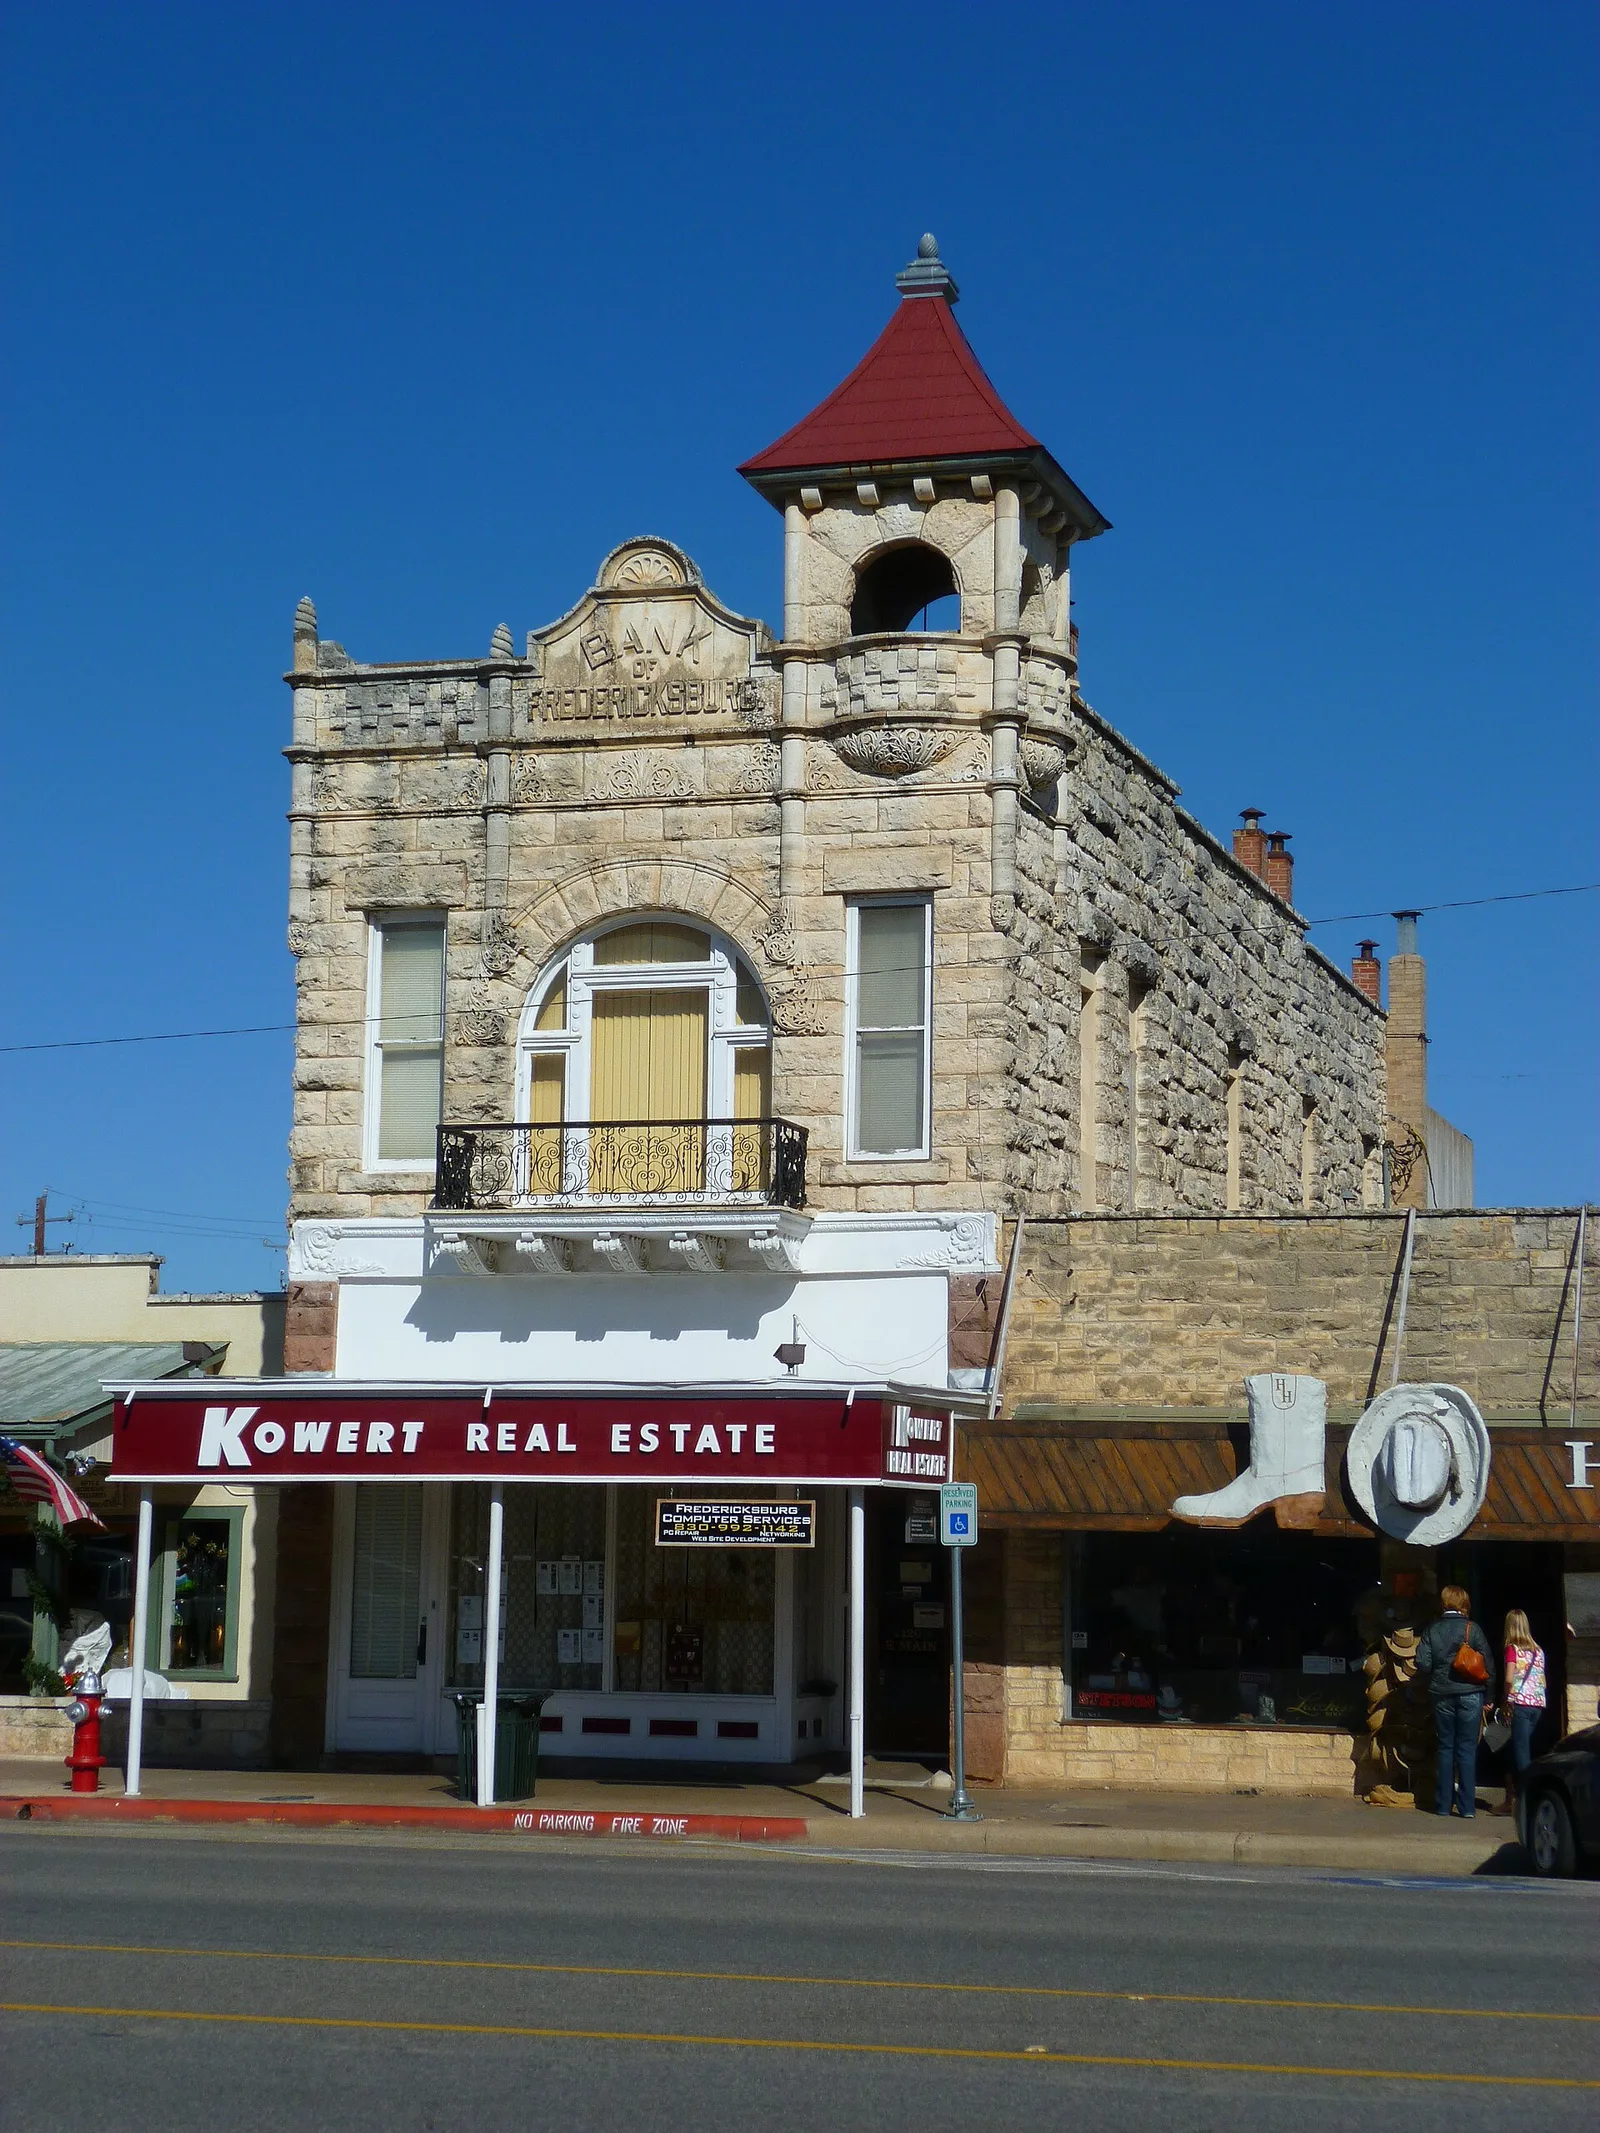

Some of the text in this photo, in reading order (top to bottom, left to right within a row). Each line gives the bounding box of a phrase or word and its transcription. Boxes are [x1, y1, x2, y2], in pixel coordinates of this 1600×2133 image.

[580, 618, 712, 671] BANK
[632, 659, 658, 681] OF
[891, 1405, 943, 1447] KOWERT
[197, 1406, 776, 1467] KOWERT REAL ESTATE
[886, 1450, 946, 1477] REAL ESTATE
[943, 1489, 974, 1499] RESERVED
[676, 1504, 798, 1515] FREDERICKSBURG
[945, 1499, 973, 1508] PARKING
[662, 1513, 811, 1525] COMPUTER SERVICES
[674, 1523, 799, 1533] 830-992-1142
[899, 1639, 937, 1652] MAIN
[1077, 1691, 1156, 1708] STETSON
[514, 1813, 688, 1835] NO PARKING FIRE ZONE
